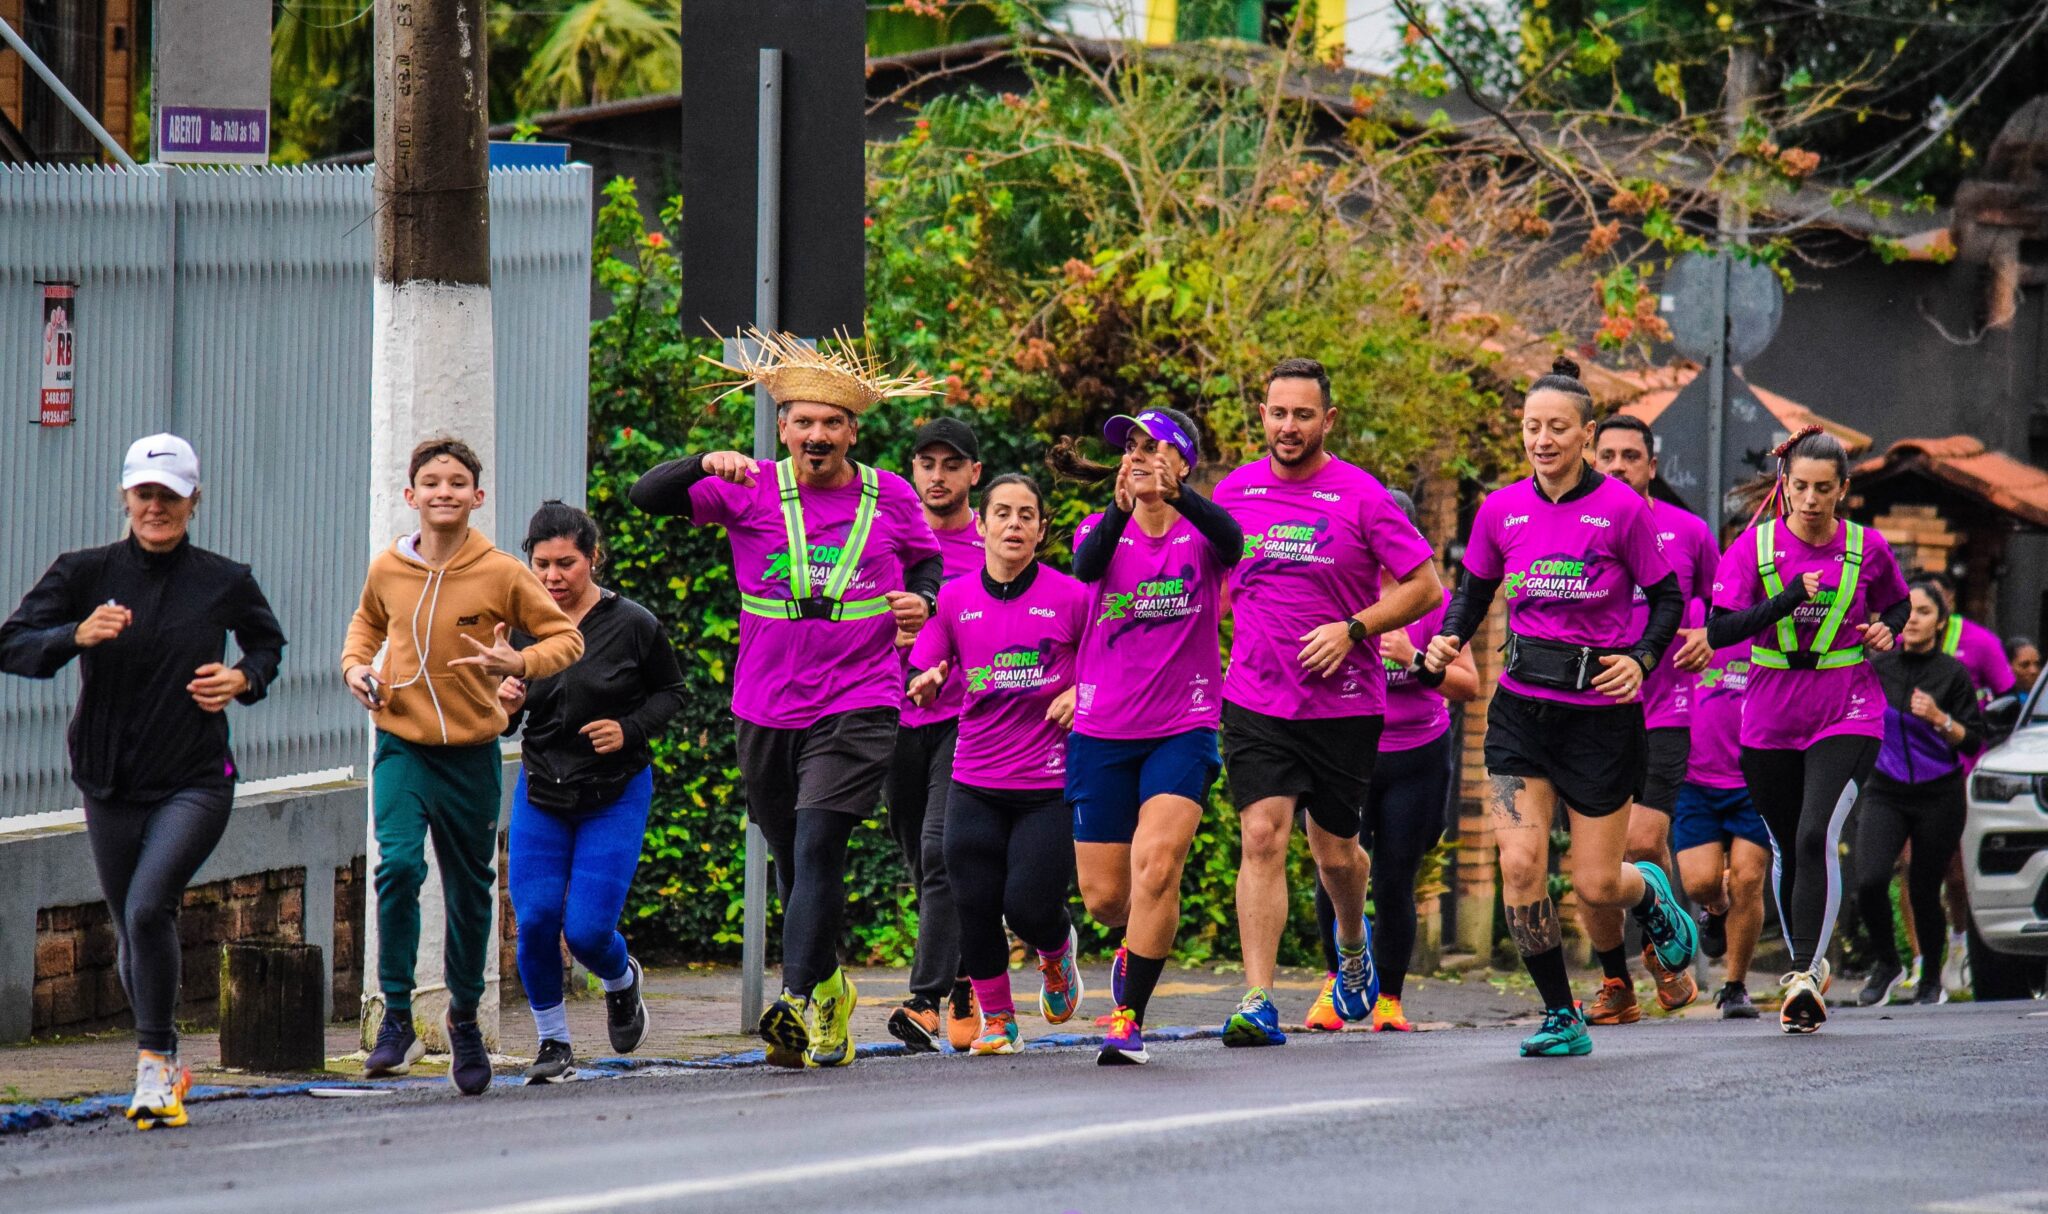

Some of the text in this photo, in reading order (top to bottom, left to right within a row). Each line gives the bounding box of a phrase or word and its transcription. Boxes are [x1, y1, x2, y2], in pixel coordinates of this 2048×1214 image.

[169, 115, 202, 144] ABERTO
[210, 120, 222, 142] Das
[223, 121, 239, 142] 7h30
[249, 121, 260, 142] 19h
[57, 332, 72, 366] RB
[1267, 524, 1316, 541] CORRE
[1264, 540, 1318, 555] GRAVATAÍ
[1263, 550, 1291, 560] CORRIDA
[1295, 553, 1335, 565] CAMINHADA
[1529, 560, 1585, 577] CORRE
[1136, 578, 1184, 597] CORRE
[1526, 577, 1590, 591] GRAVATAÍ
[1134, 593, 1190, 611] GRAVATAÍ
[1526, 588, 1558, 599] CORRIDA
[1564, 589, 1610, 600] CAMINHADA
[1133, 608, 1164, 619] CORRIDA
[993, 651, 1040, 668] CORRE
[993, 665, 1045, 682] GRAVATAÍ
[993, 680, 1021, 690] CORRIDA
[1026, 674, 1061, 688] CAMINHADA
